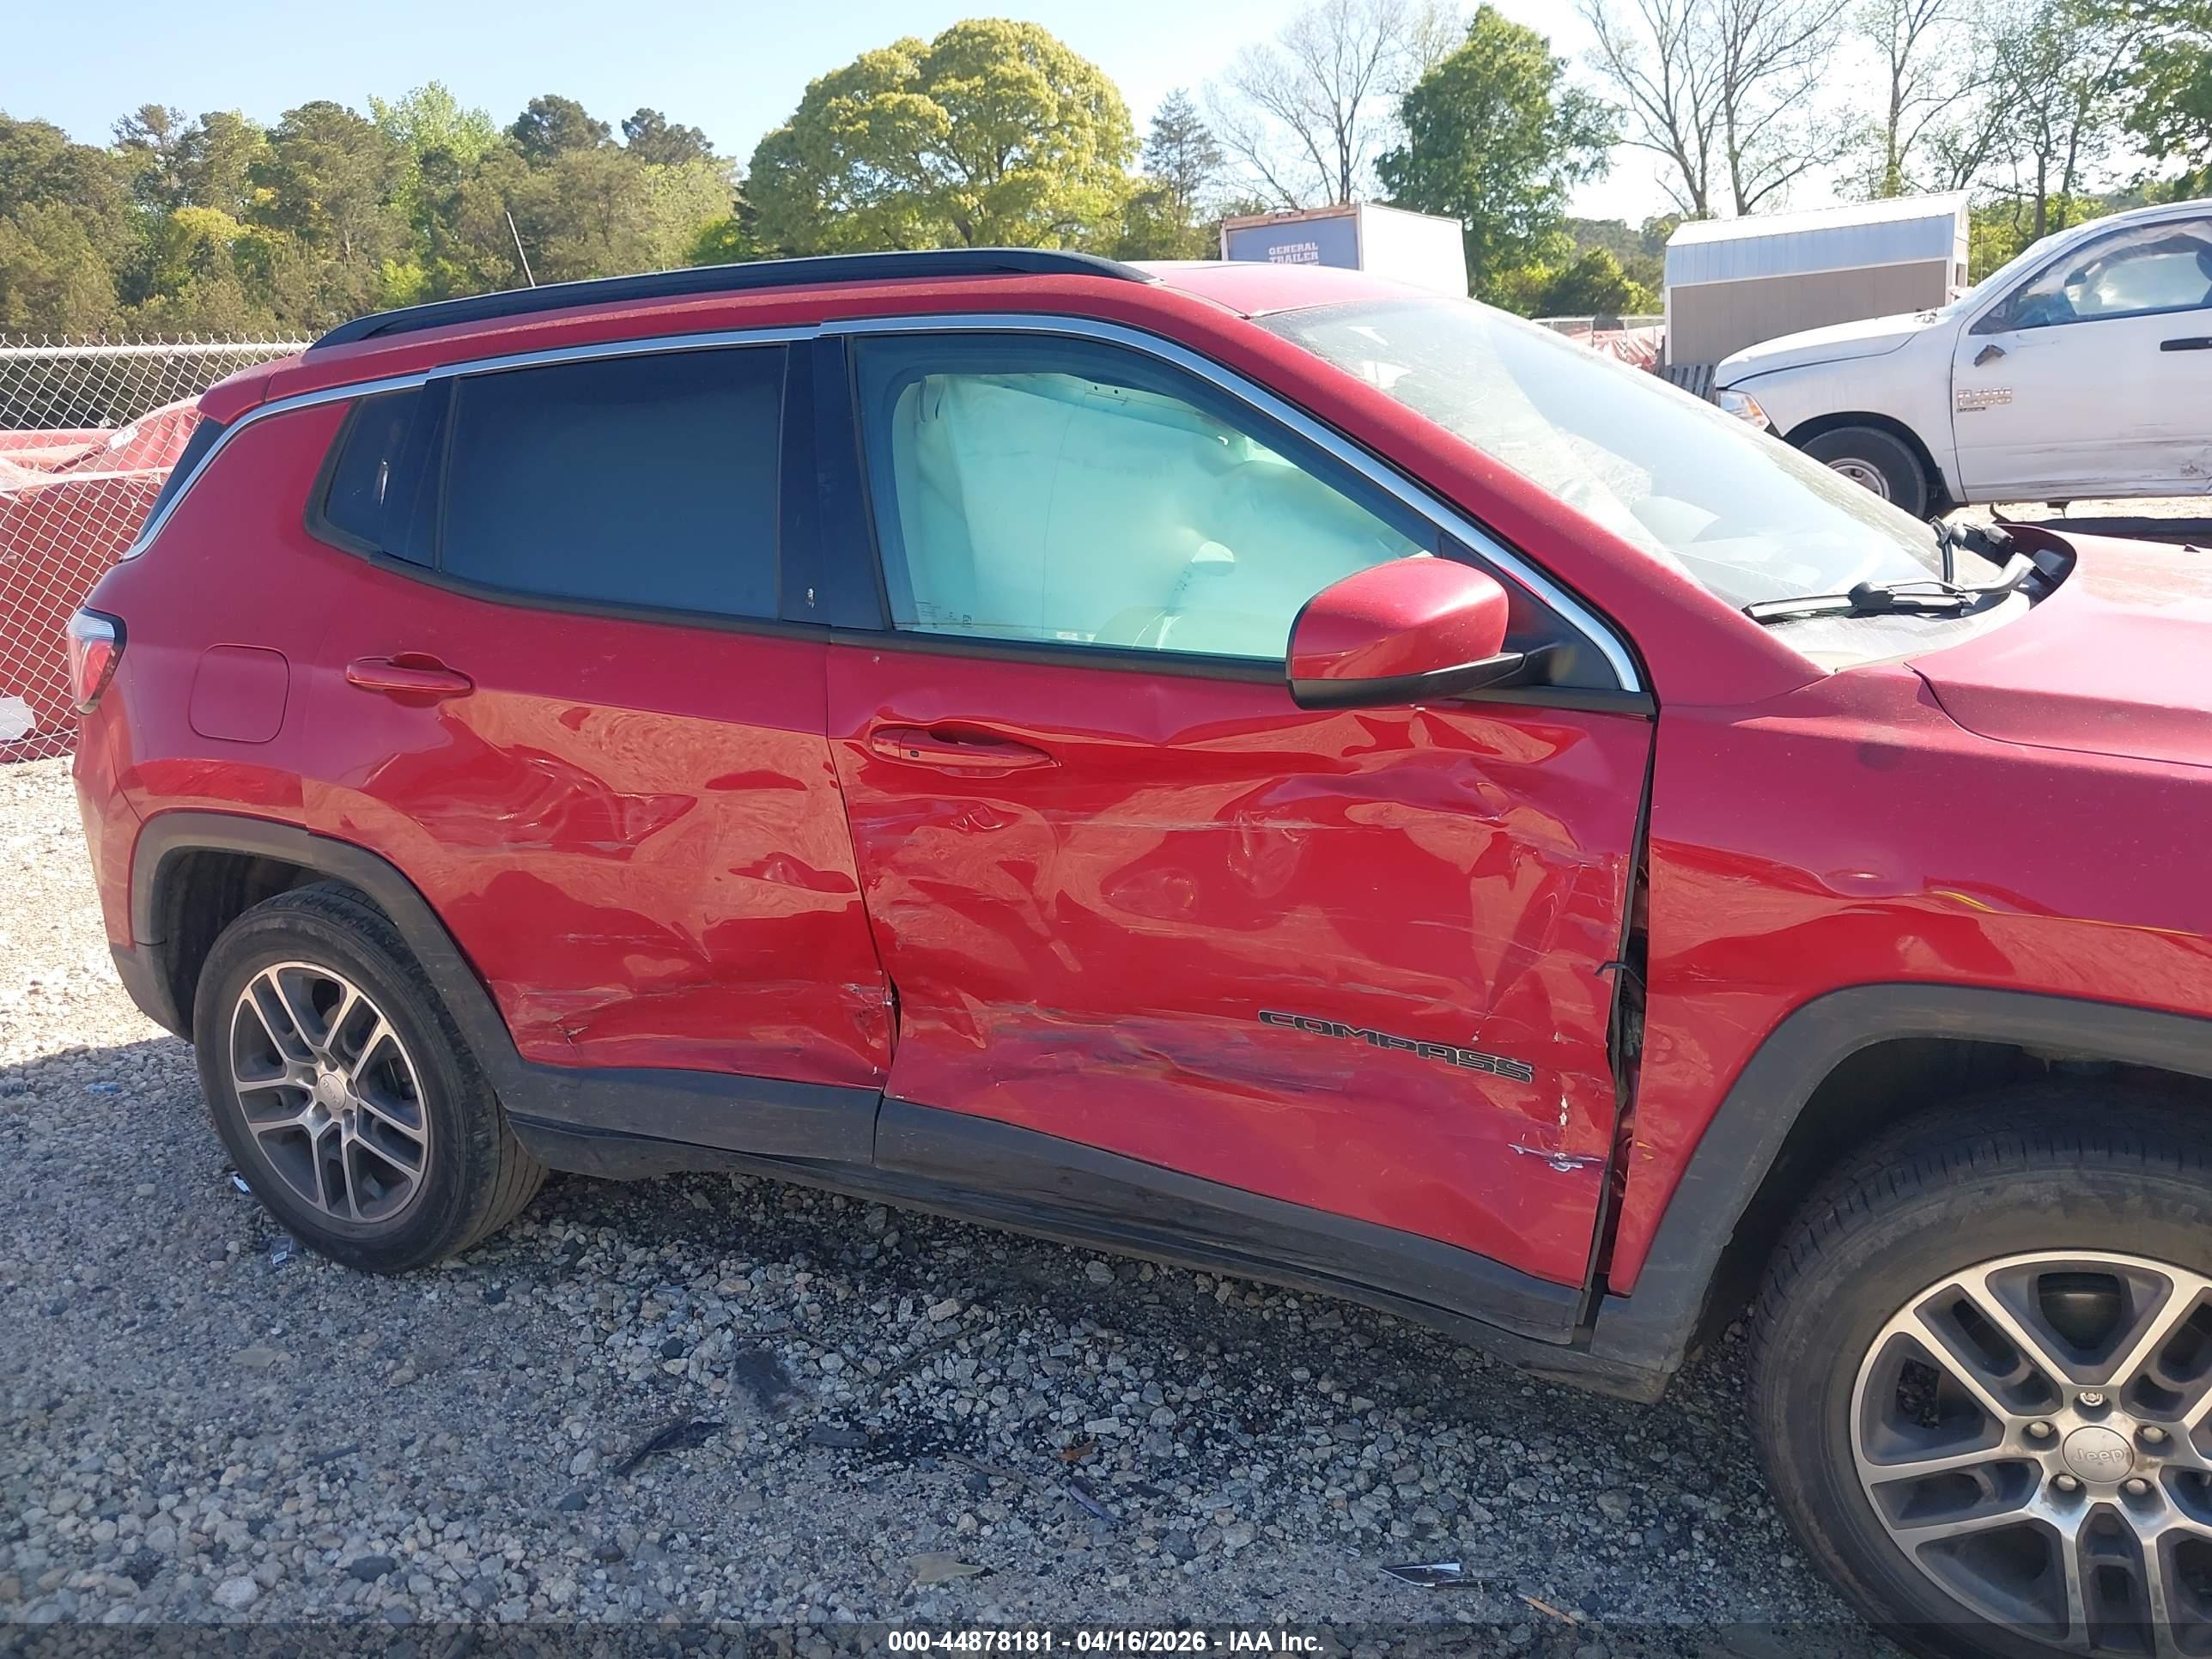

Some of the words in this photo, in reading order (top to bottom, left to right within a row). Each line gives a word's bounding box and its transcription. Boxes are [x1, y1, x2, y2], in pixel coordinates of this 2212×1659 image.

[1268, 242, 1319, 255] GENERAL
[1269, 252, 1319, 264] TRAILER
[1957, 387, 2012, 398] RAM
[1257, 1009, 1534, 1085] COMPASS
[2074, 1448, 2124, 1463] Jeep
